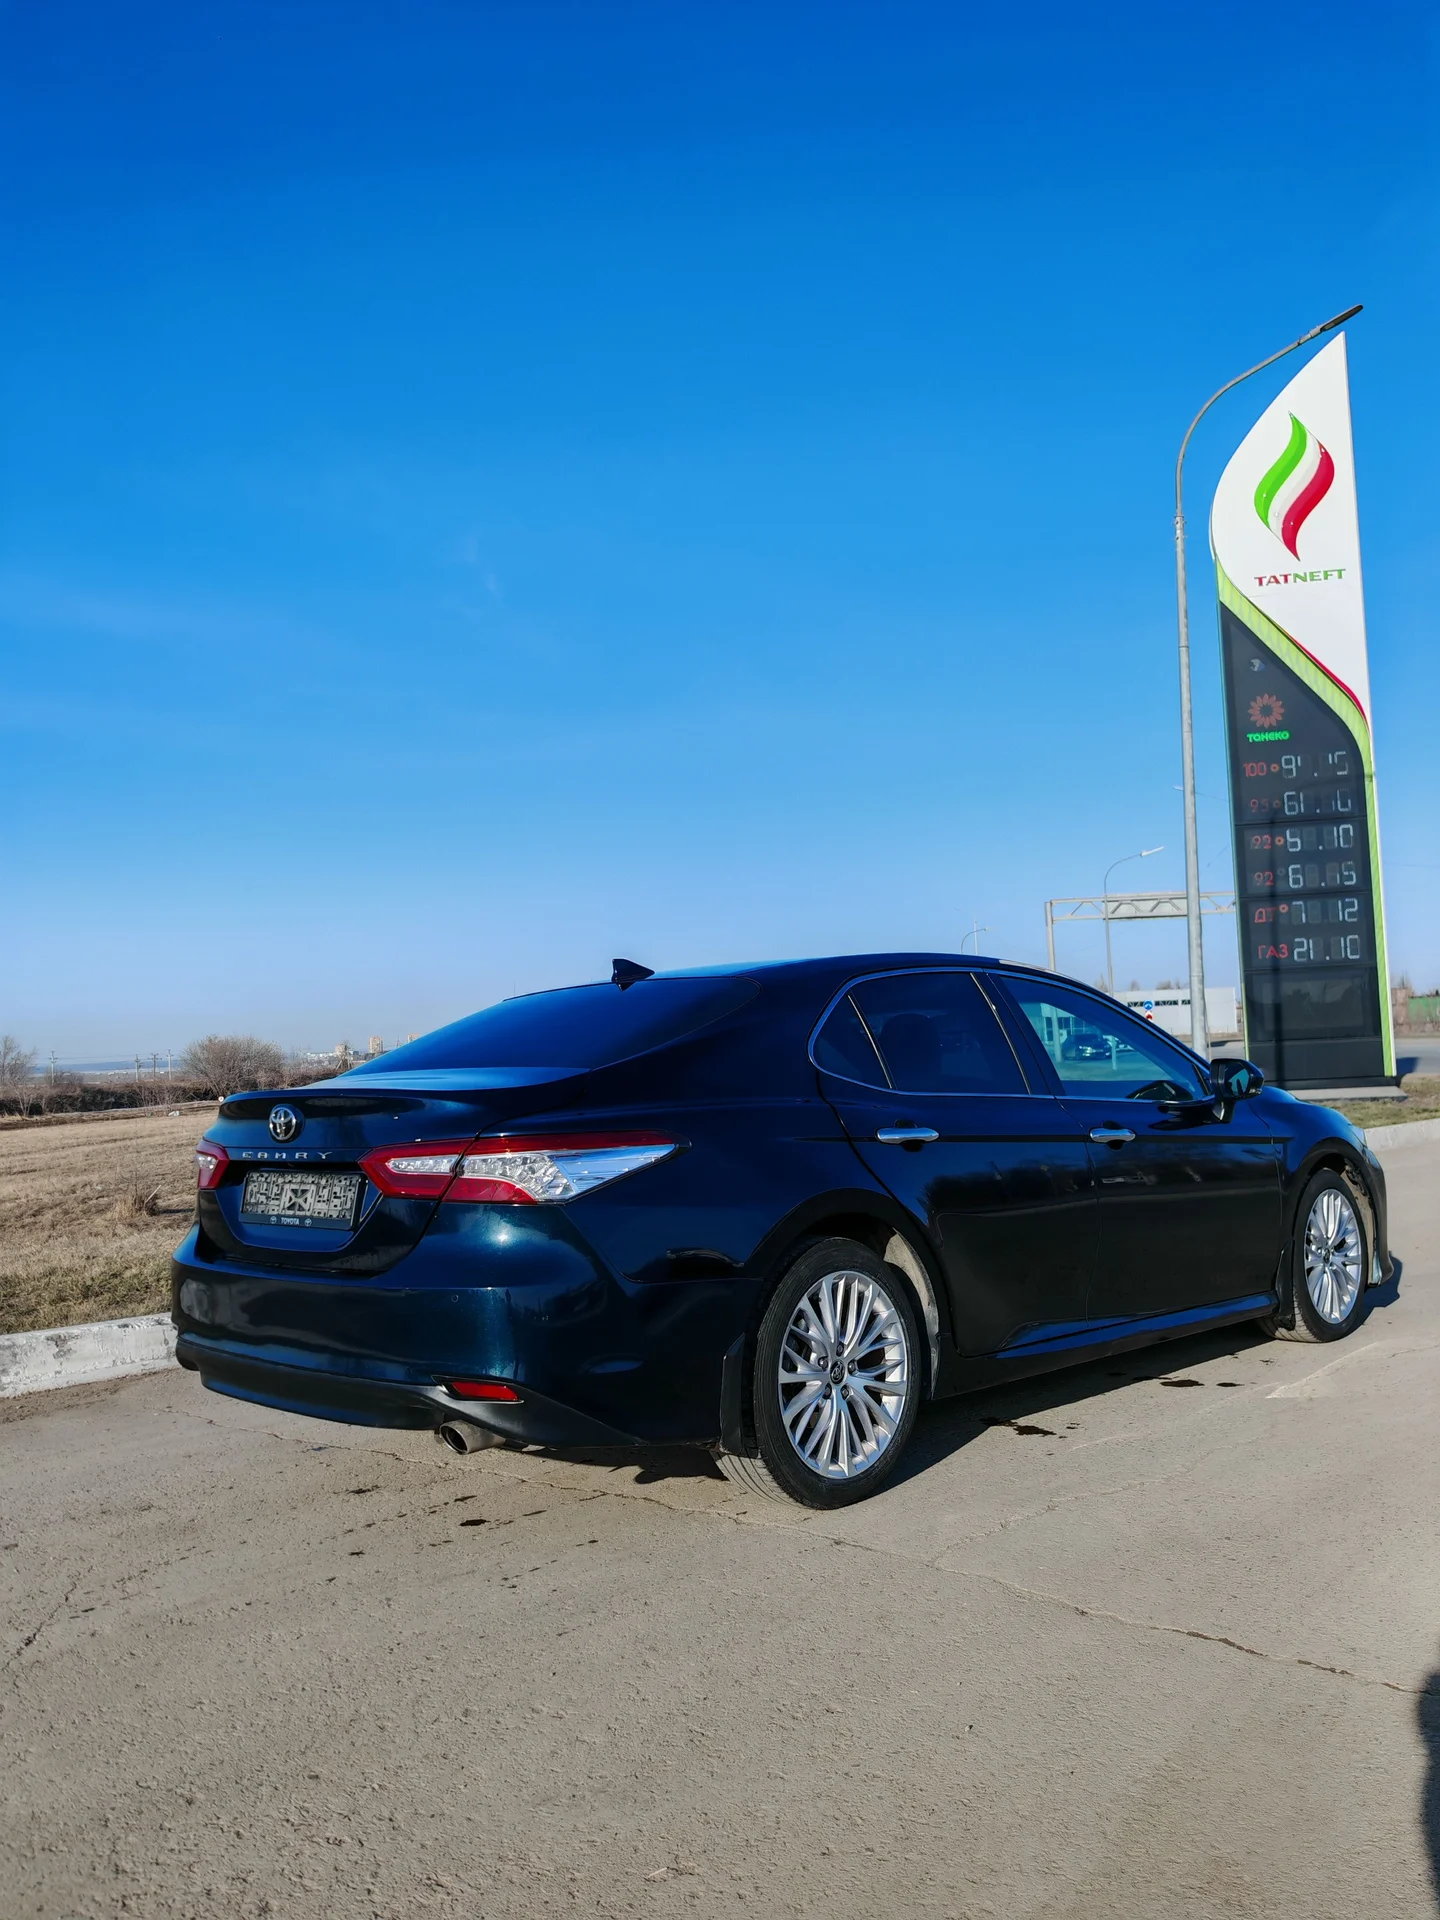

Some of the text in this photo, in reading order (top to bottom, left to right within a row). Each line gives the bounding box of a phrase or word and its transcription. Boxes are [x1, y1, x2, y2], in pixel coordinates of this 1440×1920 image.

[1254, 568, 1346, 587] TATNEFT
[1243, 762, 1267, 777] 100
[1251, 835, 1272, 849] 92
[1253, 872, 1274, 886] 92
[1254, 907, 1276, 923] ДТ
[1258, 944, 1288, 959] ГАЗ
[242, 1151, 332, 1159] CAMRY
[280, 1217, 300, 1225] TOYOTA
